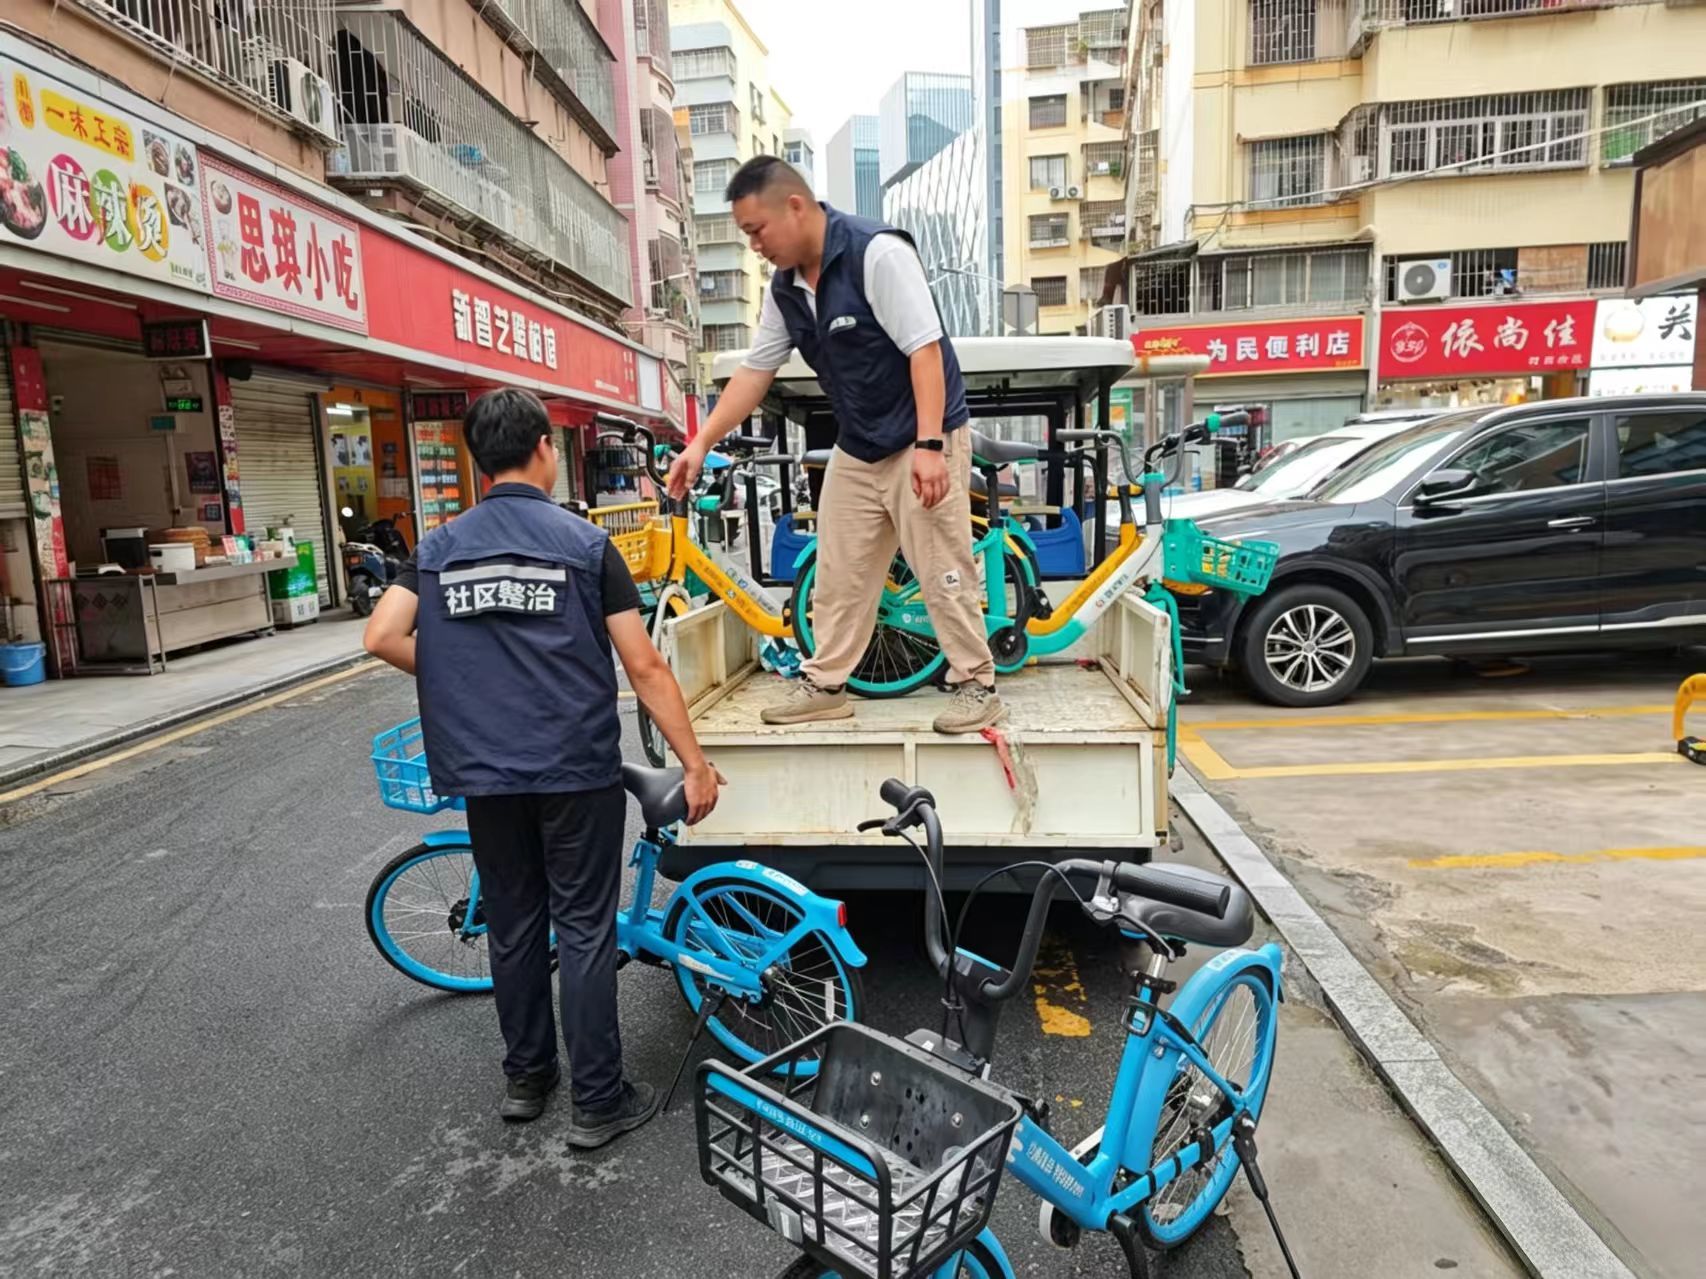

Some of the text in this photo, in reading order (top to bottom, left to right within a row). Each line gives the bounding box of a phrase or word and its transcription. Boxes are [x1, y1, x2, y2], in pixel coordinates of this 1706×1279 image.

[237, 191, 358, 311] 思琪小吃
[1206, 330, 1350, 362] 为民便利店
[1441, 314, 1578, 359] 依尚佳
[444, 580, 557, 615] 社区整治
